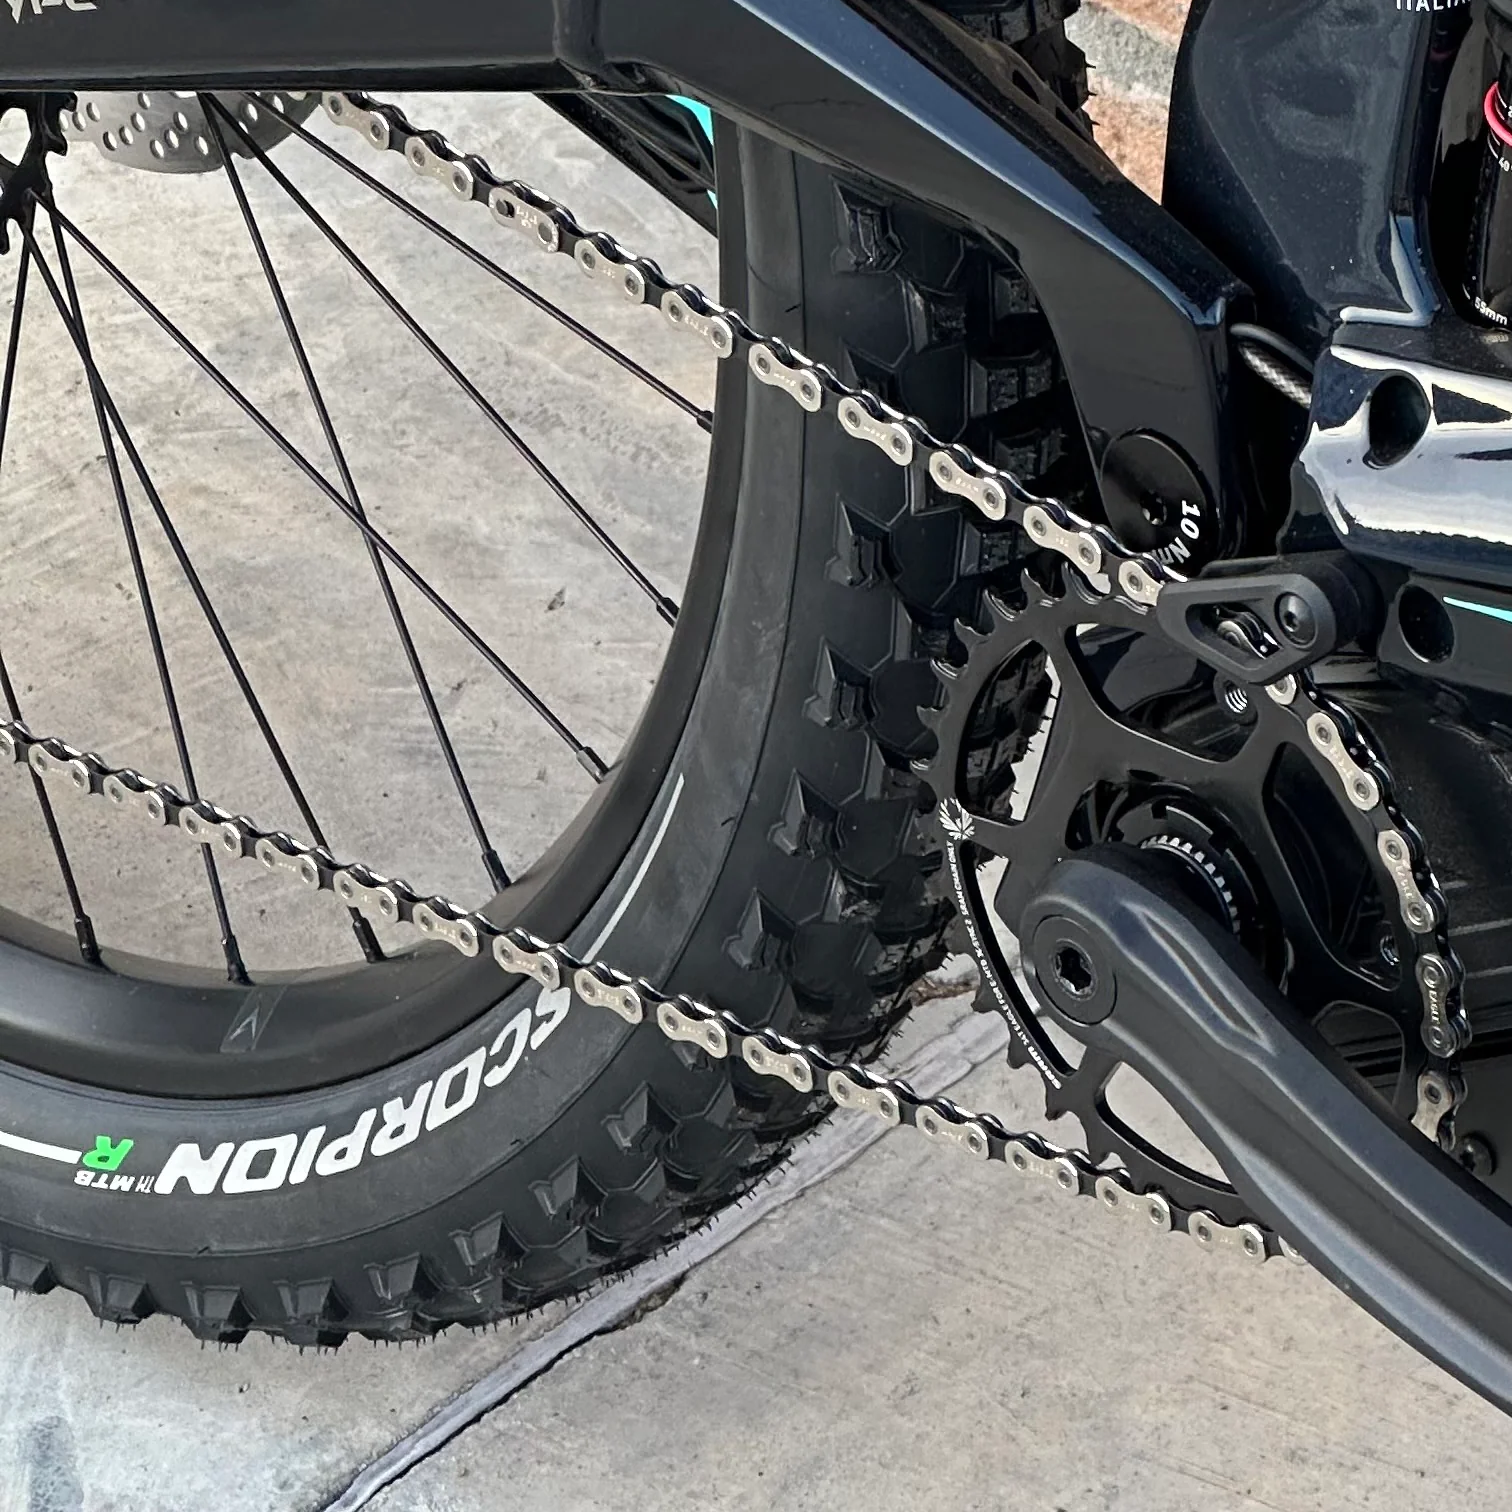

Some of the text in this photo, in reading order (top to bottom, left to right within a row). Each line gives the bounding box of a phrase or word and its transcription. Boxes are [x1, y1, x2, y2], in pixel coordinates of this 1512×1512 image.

[1475, 296, 1508, 325] 55mm
[1180, 500, 1200, 539] 10
[154, 986, 572, 1195] SCORPION
[83, 1135, 134, 1171] R
[74, 1170, 136, 1192] MTB
